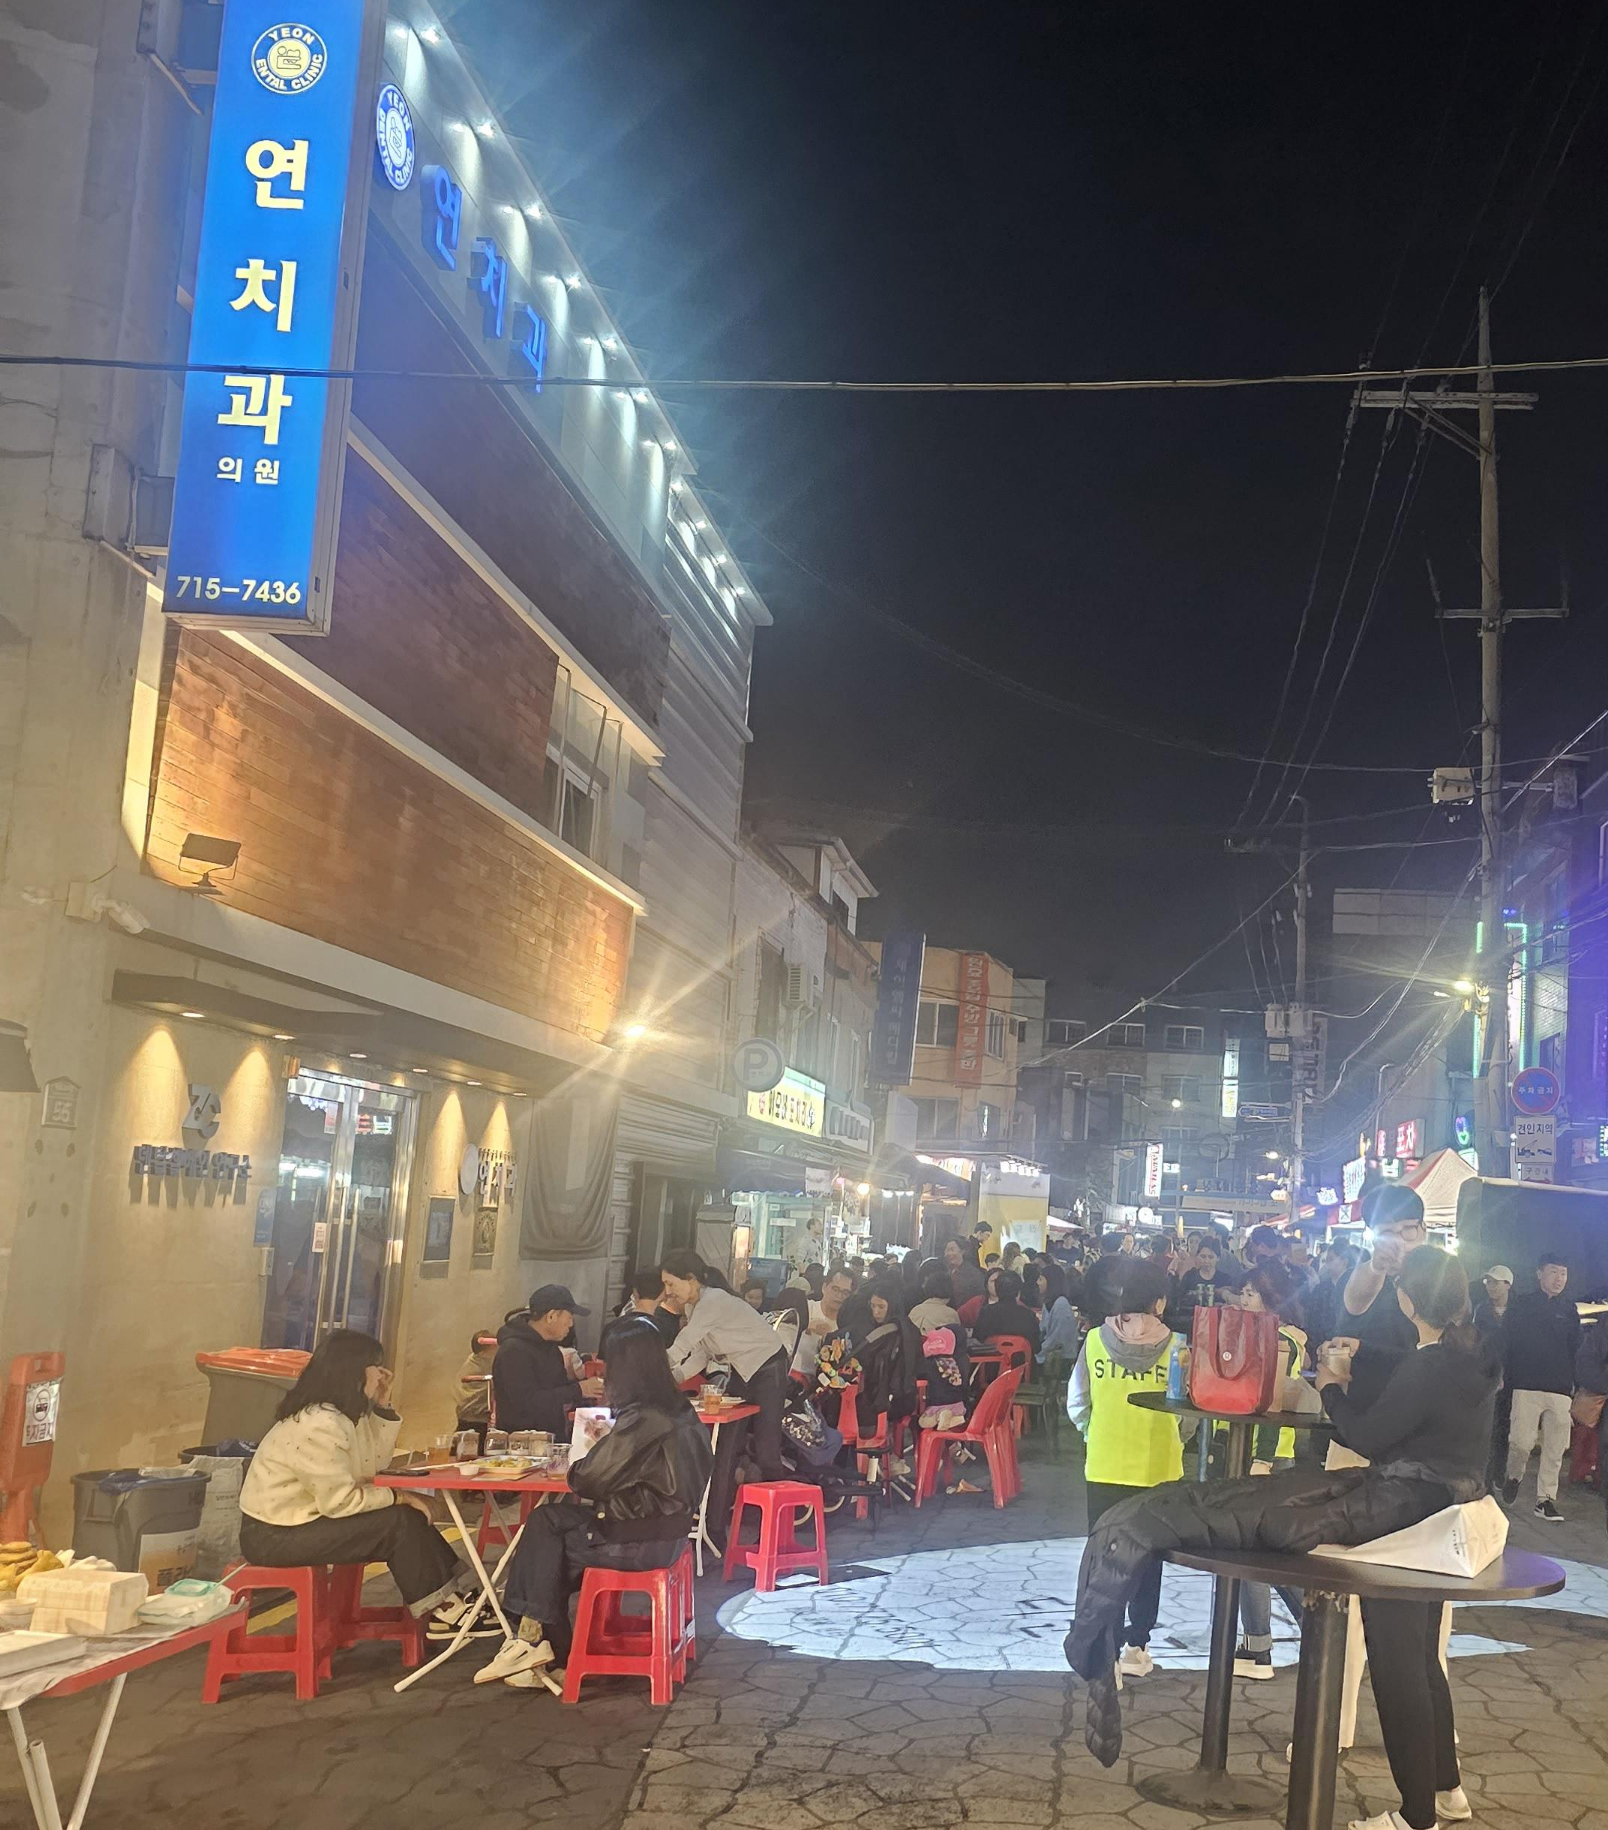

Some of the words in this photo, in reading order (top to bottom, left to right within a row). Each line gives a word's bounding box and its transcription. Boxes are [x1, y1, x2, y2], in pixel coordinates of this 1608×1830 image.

[268, 27, 315, 45] YEON
[291, 53, 323, 90] CLINIC
[386, 91, 411, 130] YEON
[377, 107, 394, 176] DENTAL
[394, 147, 413, 184] CLINIC
[216, 456, 280, 485] 의원
[175, 575, 302, 605] 715-7436
[1518, 1085, 1554, 1095] 주차금지
[1517, 1123, 1553, 1135] 견인지역
[1094, 1359, 1167, 1384] STAFF
